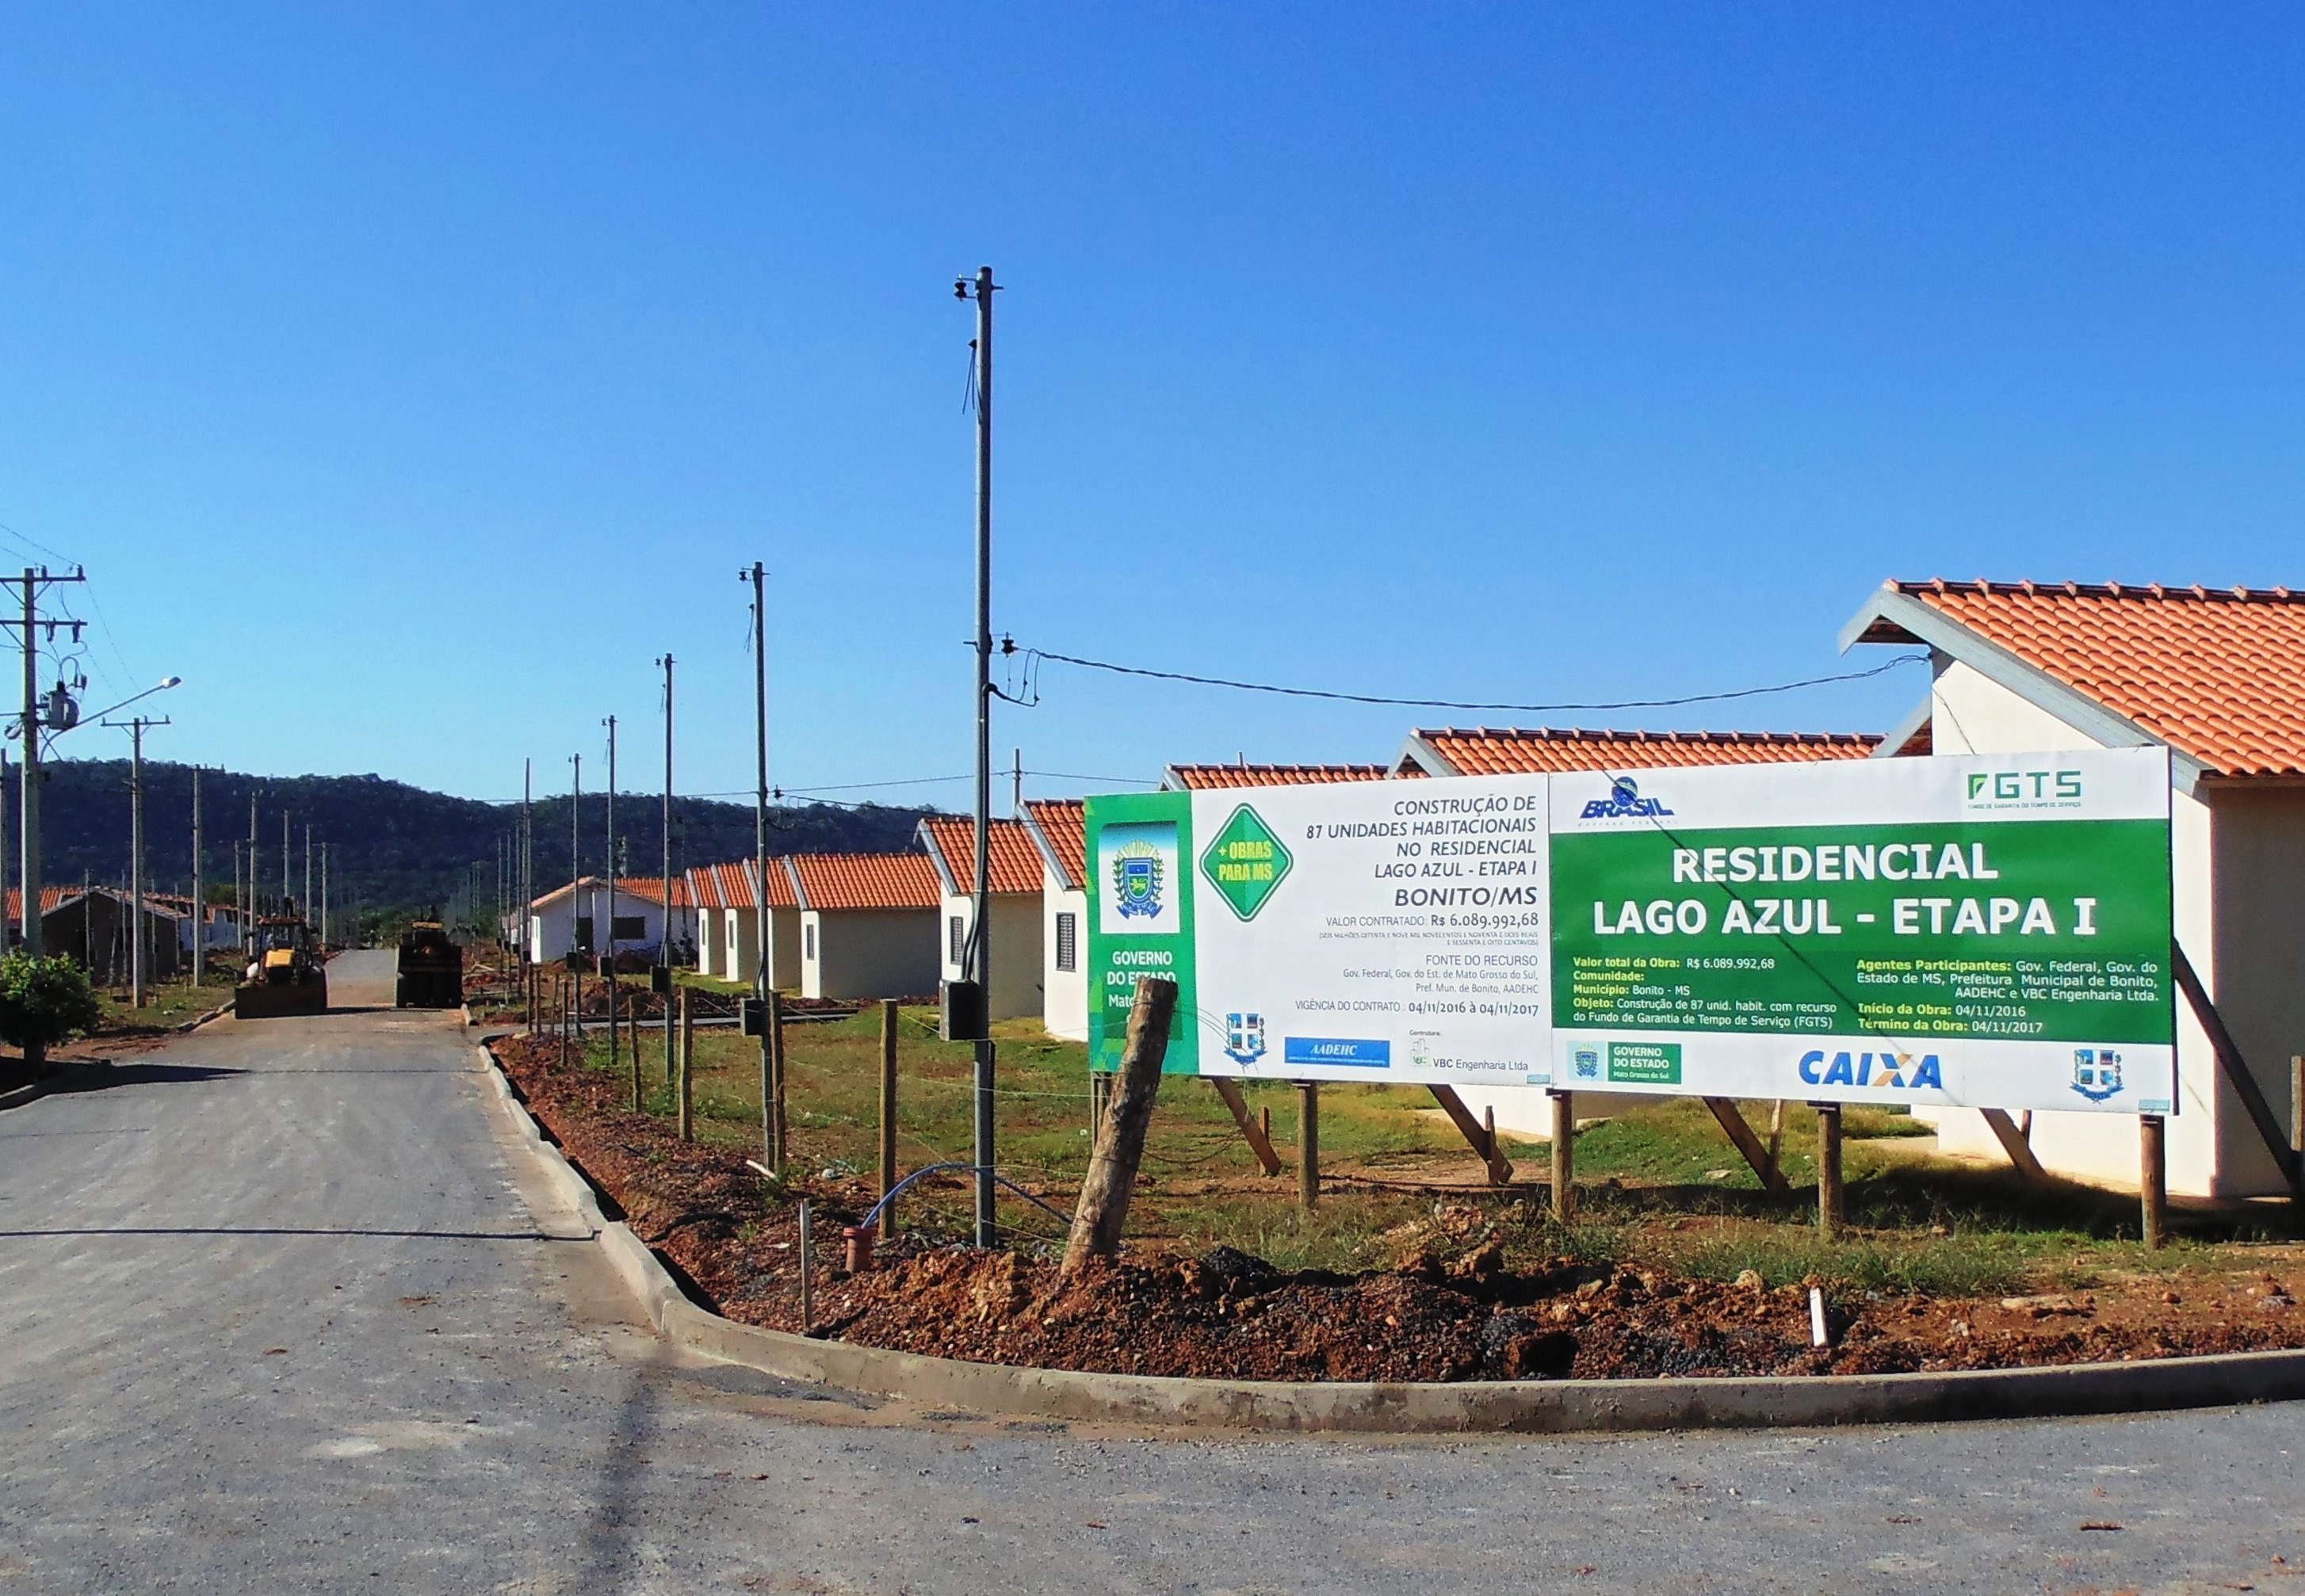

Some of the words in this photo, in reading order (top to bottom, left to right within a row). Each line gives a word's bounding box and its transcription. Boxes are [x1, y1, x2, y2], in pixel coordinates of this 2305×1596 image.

[1968, 770, 2081, 800] FGTS
[1394, 794, 1508, 816] CONSTRUÇÃO
[1513, 796, 1536, 811] DE
[1580, 796, 1675, 819] BRASIL
[1306, 825, 1322, 839] 87
[1328, 822, 1407, 838] UNIDADES
[1412, 818, 1536, 836] HABITACIONAIS
[1229, 842, 1271, 857] OBRAS
[1397, 842, 1421, 857] NO
[1431, 839, 1536, 856] RESIDENCIAL
[1374, 863, 1416, 878] LAGO
[1420, 862, 1463, 877] AZUL
[1478, 861, 1527, 876] ETAPA
[1672, 842, 1998, 883] RESIDENCIAL
[1219, 865, 1248, 880] PARA
[1253, 865, 1272, 880] MS
[1395, 887, 1537, 907] BONITO/MS
[1326, 917, 1356, 926] VALOR
[1432, 914, 1445, 927] R$
[1450, 913, 1539, 929] 6.089.992,68
[1593, 899, 1707, 935] LAGO
[1722, 898, 1841, 935] AZUL
[1856, 914, 1875, 924] -
[1894, 897, 2056, 935] ETAPA
[2074, 897, 2097, 935] I
[1112, 951, 1172, 965] GOVERNO
[1426, 955, 1462, 966] FONTE
[1465, 956, 1481, 966] DO
[1484, 955, 1538, 966] RECURSO
[1573, 956, 1602, 968] Valor
[1605, 956, 1630, 968] total
[1633, 957, 1647, 968] da
[1649, 957, 1680, 968] Obra:
[1686, 957, 1700, 970] R$
[1703, 958, 1776, 971] 6.089.992,68
[1344, 969, 1359, 979] Gov.
[1362, 968, 1393, 979] Federal,
[1395, 970, 1411, 979] Gov.
[1414, 969, 1424, 979] do
[1427, 969, 1440, 979] Est.
[1443, 970, 1453, 979] de
[1479, 970, 1508, 979] Grosso
[1510, 970, 1520, 979] do
[1523, 970, 1539, 980] Sul,
[1856, 960, 1911, 972] Agentes
[1916, 960, 2011, 973] Participantes:
[2016, 961, 2043, 972] Gov.
[2049, 960, 2100, 974] Federal,
[2106, 961, 2135, 973] Gov.
[2141, 961, 2158, 972] do
[1107, 971, 1126, 985] DO
[1573, 971, 1645, 981] Comunidade:
[1857, 973, 1898, 983] Estado
[1902, 973, 1917, 983] de
[1922, 974, 1945, 985] MS,
[1950, 973, 2012, 985] Prefeitura
[2021, 975, 2083, 988] Municipal
[2088, 976, 2104, 987] de
[2109, 976, 2158, 988] Bonito,
[1416, 983, 1433, 992] Pref.
[1435, 983, 1456, 993] Mun.
[1459, 983, 1470, 993] de
[1471, 983, 1500, 995] Bonito,
[1503, 984, 1539, 994] AADEHC
[1573, 984, 1630, 997] Município:
[1632, 985, 1665, 995] Bonito
[1675, 986, 1690, 995] MS
[1955, 988, 2006, 998] AADEHC
[2020, 988, 2047, 999] VBC
[2051, 989, 2122, 1002] Engenharia
[2127, 990, 2159, 1002] Ltda.
[1295, 999, 1335, 1010] VIGÊNCIA
[1337, 1001, 1351, 1011] DO
[1353, 1001, 1401, 1011] CONTRATO
[1409, 1002, 1466, 1014] 04/11/2016
[1470, 1001, 1476, 1014] à
[1480, 1002, 1539, 1017] 04/11/2017
[1573, 998, 1614, 1009] Objeto:
[1616, 998, 1672, 1011] Construção
[1676, 999, 1688, 1010] de
[1691, 1000, 1703, 1010] 87
[1707, 1000, 1732, 1011] unid.
[1736, 1001, 1766, 1012] habit.
[1770, 1003, 1792, 1012] com
[1796, 1004, 1837, 1013] recurso
[1858, 1002, 1894, 1014] Início
[1898, 1002, 1913, 1014] da
[1917, 1003, 1951, 1015] Obra:
[1955, 1005, 2026, 1018] 04/11/2016
[1573, 1012, 1585, 1021] do
[1588, 1012, 1619, 1022] Fundo
[1622, 1013, 1634, 1022] de
[1637, 1013, 1679, 1024] Garantia
[1682, 1014, 1695, 1024] de
[1698, 1014, 1731, 1027] Tempo
[1734, 1015, 1747, 1025] de
[1751, 1015, 1791, 1028] Serviço
[1794, 1016, 1833, 1029] (FGTS)
[1858, 1018, 1909, 1030] Término
[1913, 1019, 1928, 1030] da
[1932, 1019, 1967, 1032] Obra:
[1972, 1021, 2043, 1033] 04/11/2017
[1614, 1046, 1662, 1056] GOVERNO
[1433, 1059, 1453, 1068] VBC
[1456, 1059, 1506, 1071] Engenharia
[1508, 1061, 1528, 1071] Ltda
[1614, 1058, 1628, 1067] DO
[1630, 1059, 1669, 1069] ESTADO
[1799, 1050, 1942, 1089] CAIXA
